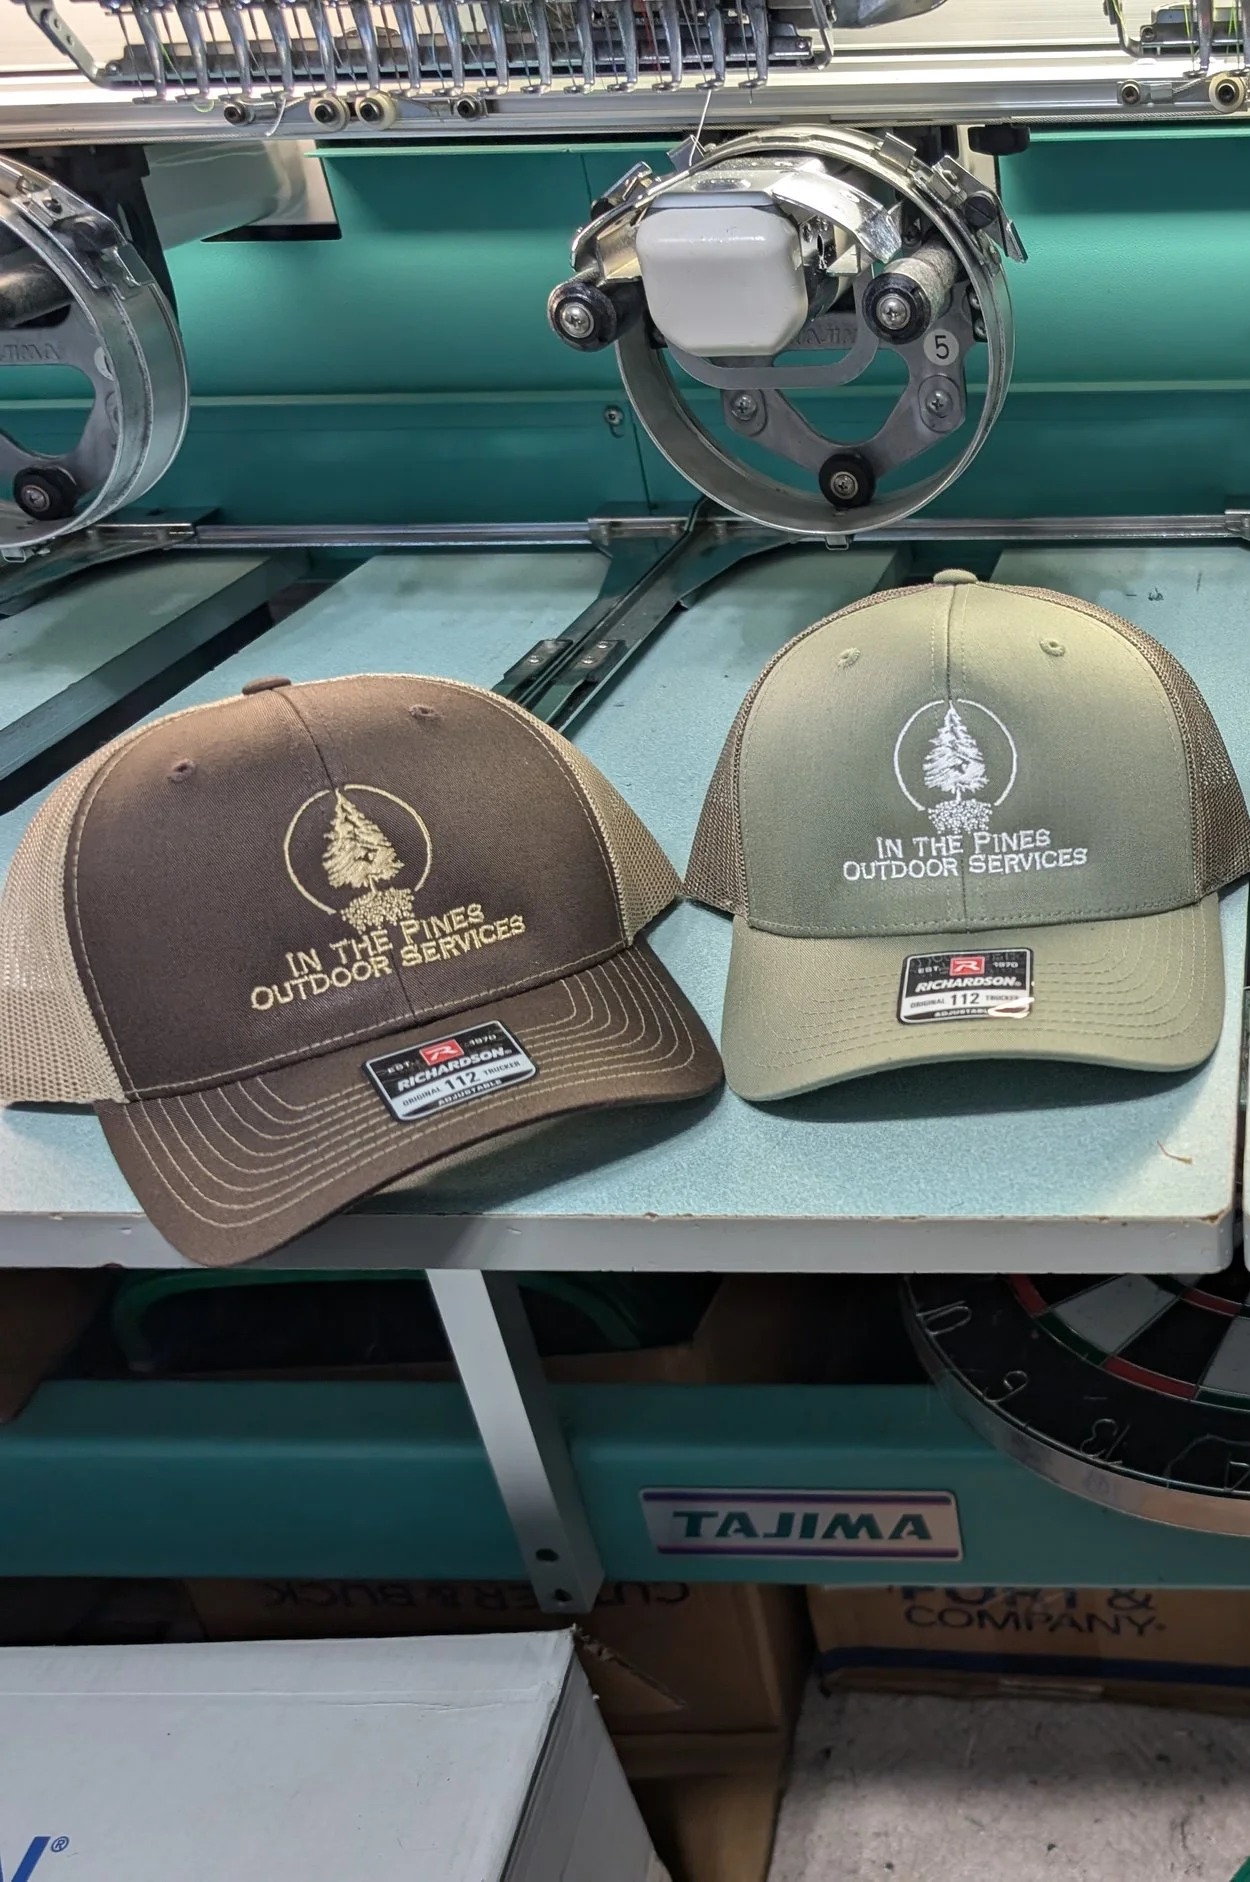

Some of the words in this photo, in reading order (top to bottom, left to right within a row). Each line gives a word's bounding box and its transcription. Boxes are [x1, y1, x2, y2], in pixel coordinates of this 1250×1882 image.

[934, 334, 950, 360] 5
[876, 836, 904, 859] IN
[912, 834, 964, 858] THE
[973, 828, 1051, 854] PINES
[843, 858, 959, 881] OUTDOOR
[968, 847, 1088, 876] SERVICES
[285, 948, 323, 978] IN
[329, 928, 394, 965] THE
[399, 902, 485, 945] PINES
[250, 954, 393, 1011] OUTDOOR
[399, 914, 527, 968] SERVICES
[950, 992, 981, 1006] 112
[402, 1086, 442, 1108] ORIGINAL
[444, 1070, 482, 1091] 112
[483, 1060, 522, 1077] TRUCKER
[438, 1079, 503, 1106] ADJUSTABLE
[671, 1510, 933, 1541] TAJIMA
[264, 1582, 416, 1608] BUCK
[470, 1582, 691, 1610] CUTER
